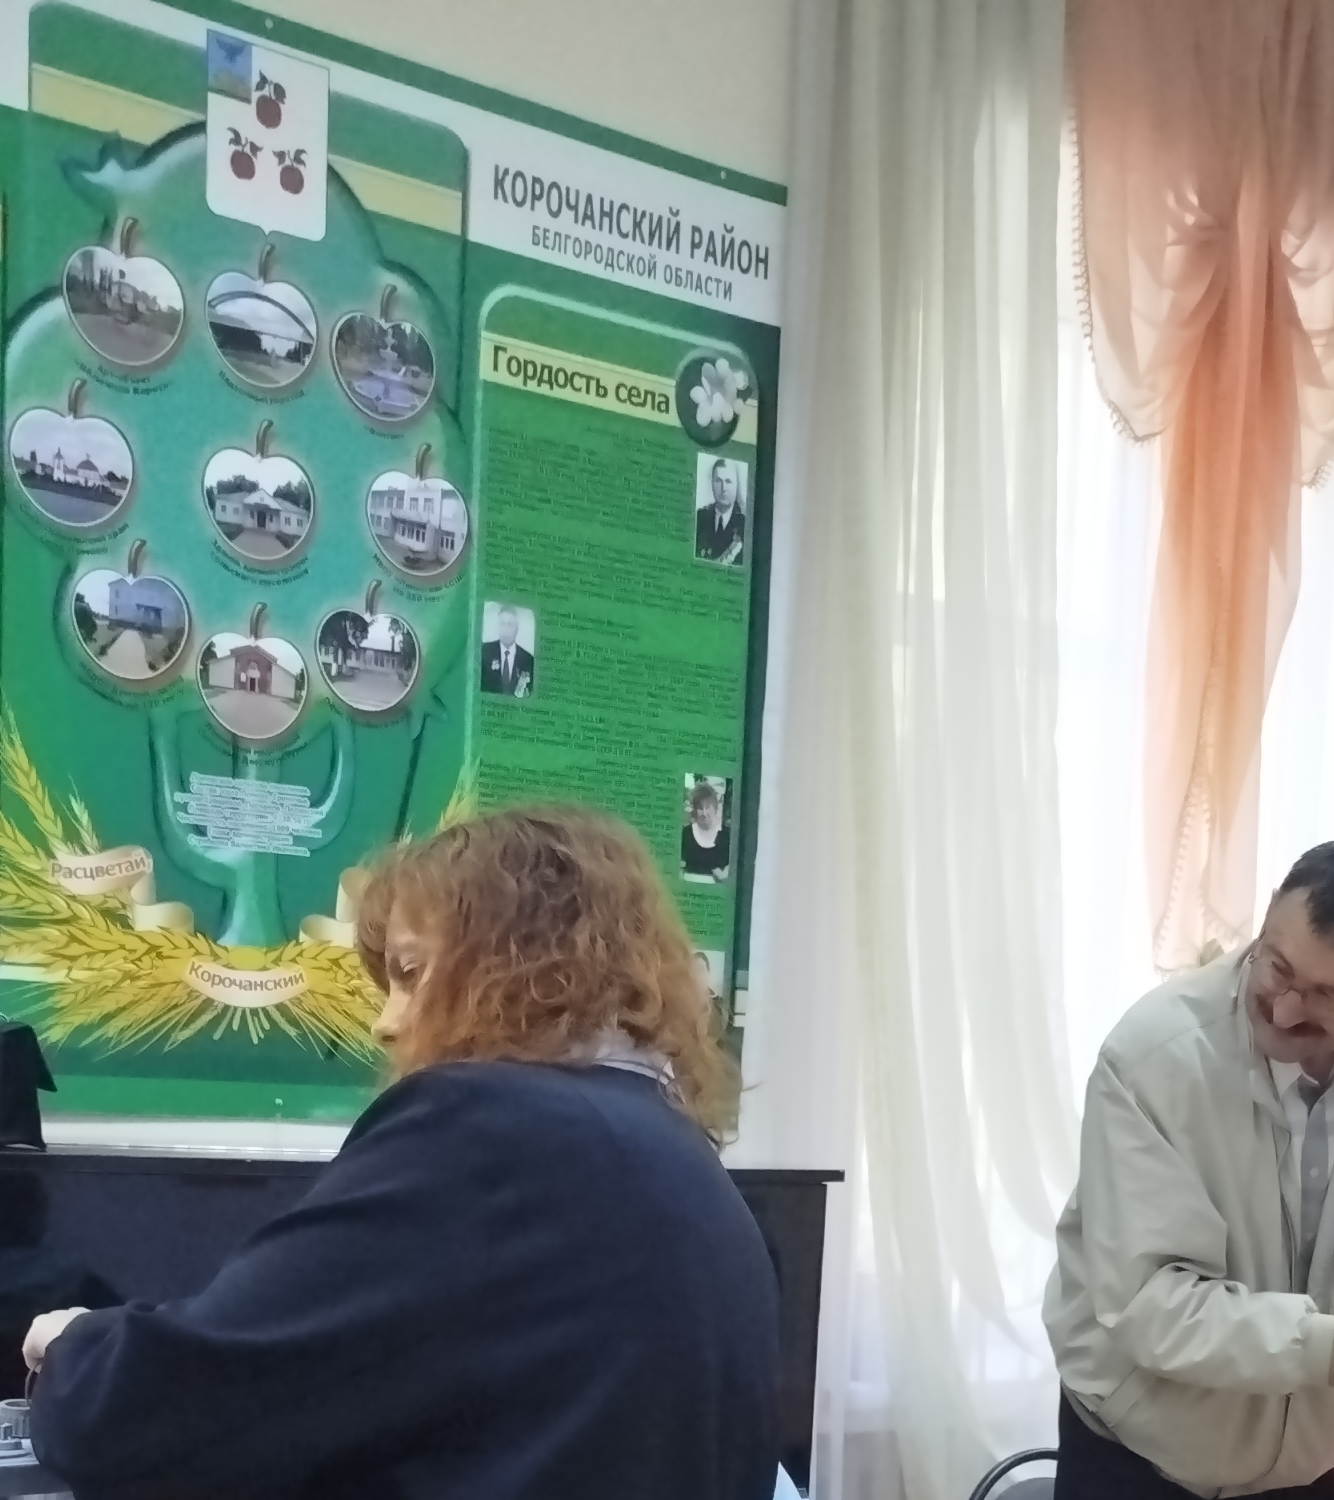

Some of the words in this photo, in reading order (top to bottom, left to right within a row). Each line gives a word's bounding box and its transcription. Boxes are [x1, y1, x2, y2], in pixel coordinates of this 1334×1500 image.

[493, 163, 681, 255] КОРОЧАНСКИЙ
[689, 223, 769, 280] РАЙОН
[531, 225, 658, 281] БЕЛГОРОДСКОЙ
[663, 264, 733, 302] ОБЛАСТИ
[492, 343, 609, 400] Гордость
[614, 379, 670, 415] села
[188, 961, 306, 992] Корочанский
